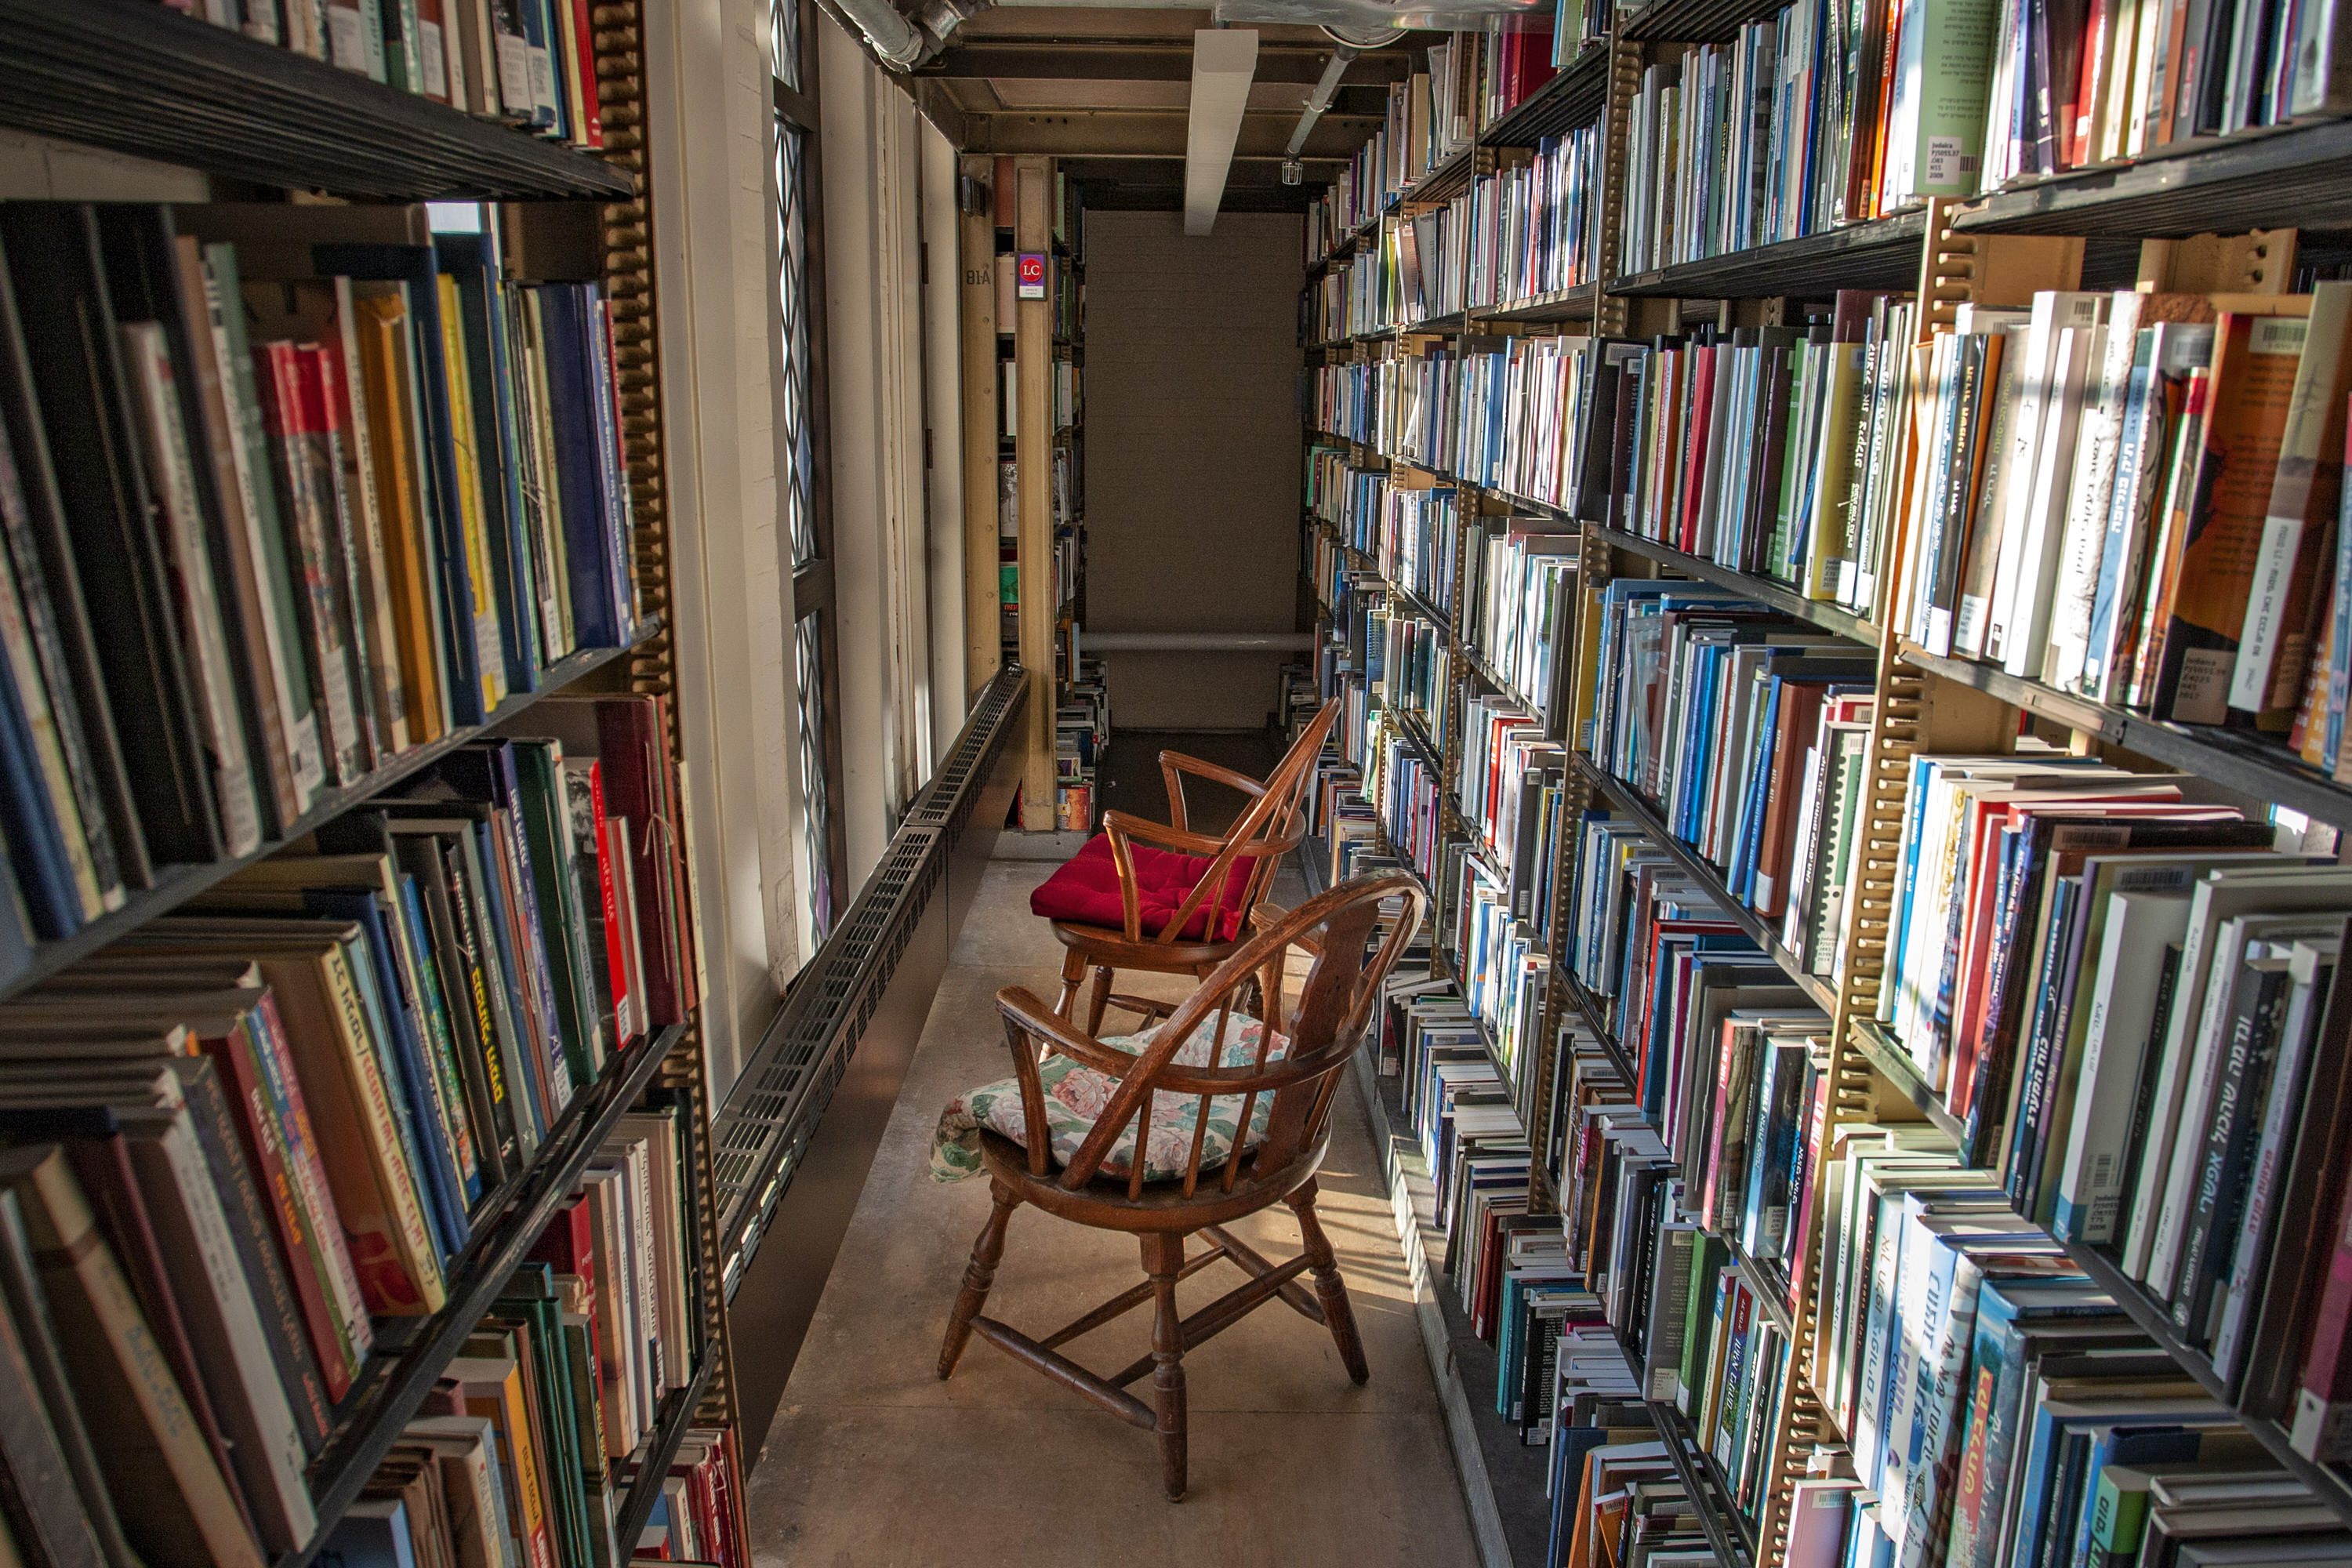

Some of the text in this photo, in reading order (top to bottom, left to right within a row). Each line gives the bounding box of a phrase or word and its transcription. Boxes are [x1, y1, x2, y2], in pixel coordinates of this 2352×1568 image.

[1023, 265, 1040, 276] LC
[1864, 343, 1876, 384] להציל
[1860, 394, 1870, 412] את
[1850, 420, 1871, 467] ציקלופ
[2107, 442, 2136, 533] תיק פנלופה
[466, 964, 496, 1047] בנפתולי
[483, 1043, 506, 1105] הימים
[2026, 1033, 2049, 1129] כוח המערב
[374, 1116, 397, 1156] של
[1809, 1097, 1824, 1150] רם אורן
[2194, 1011, 2252, 1218] ונדמה שהכול אפשרי
[1879, 1229, 1891, 1271] איך
[1874, 1263, 1886, 1316] חלפו
[1867, 1316, 1881, 1396] ציפורים
[1890, 1348, 1899, 1377] כל
[1723, 1367, 1739, 1413] ביניהם
[1922, 1331, 1956, 1464] על אש נמוכה
[1962, 1363, 1992, 1501] רק בלחש
